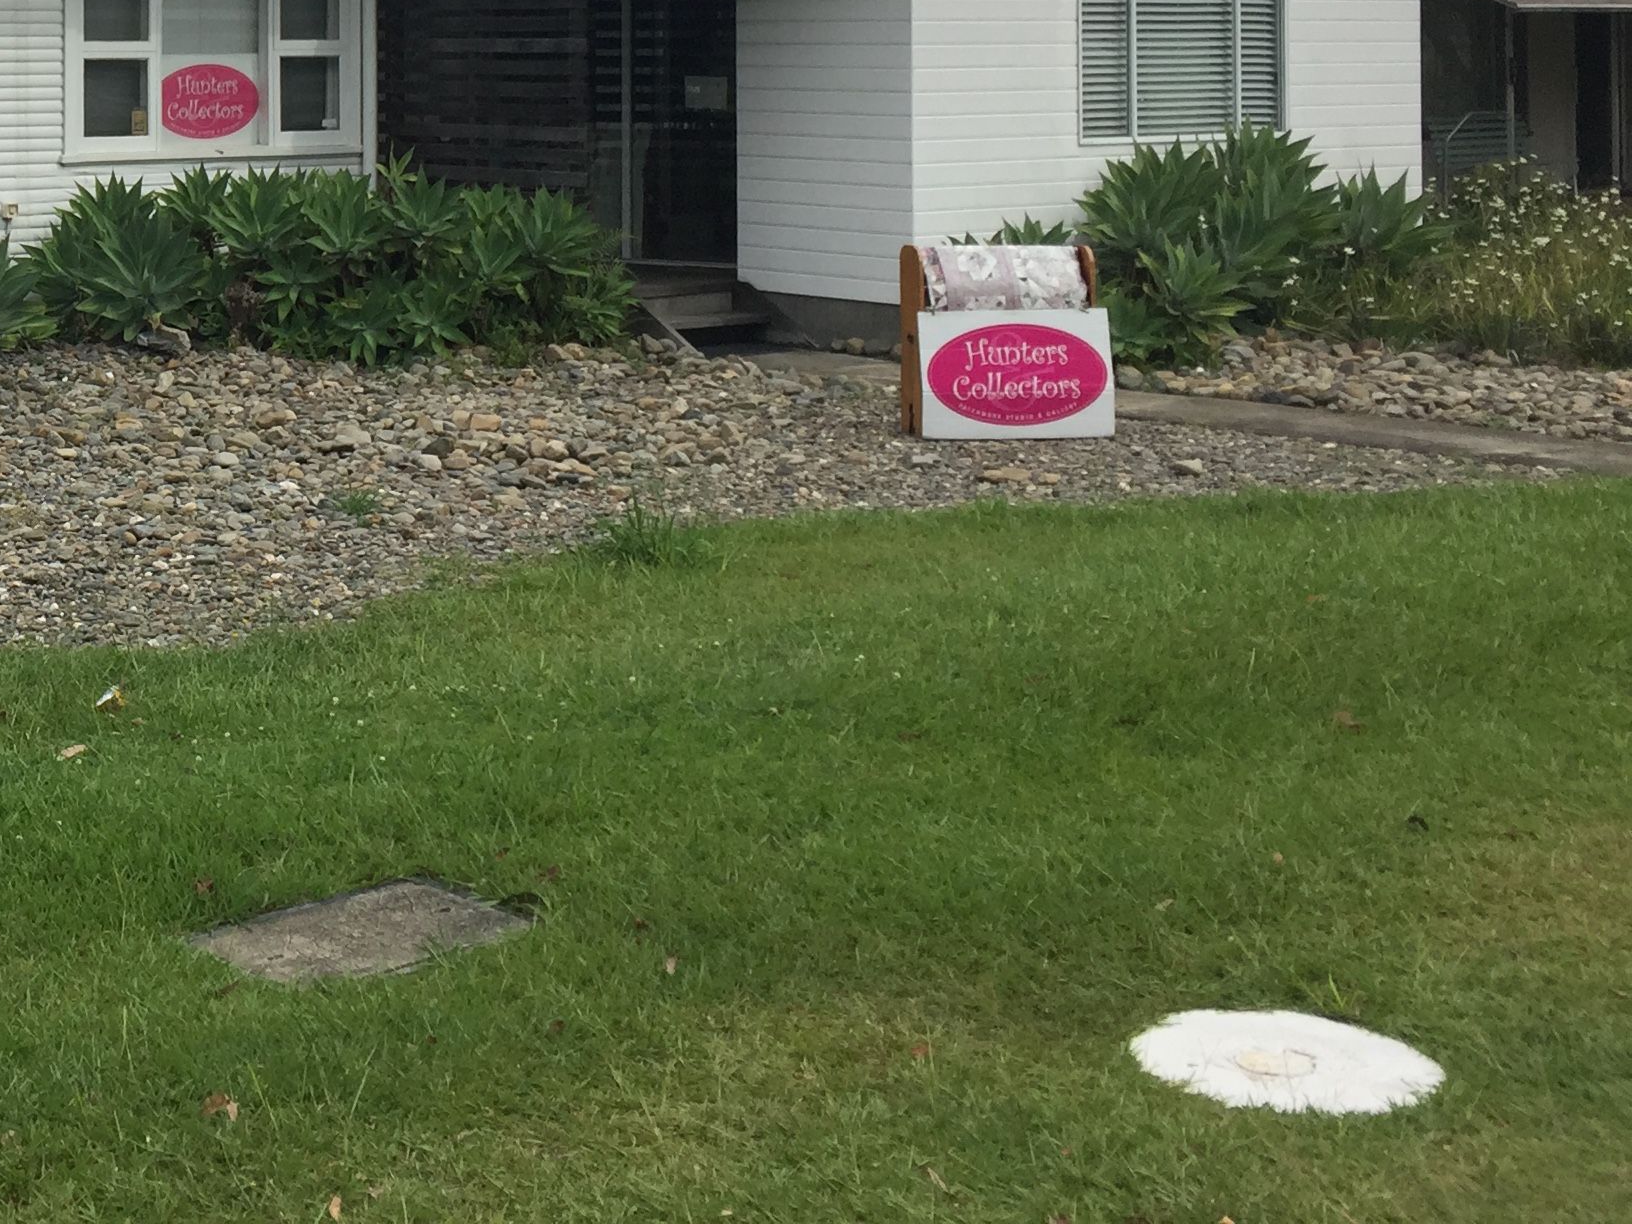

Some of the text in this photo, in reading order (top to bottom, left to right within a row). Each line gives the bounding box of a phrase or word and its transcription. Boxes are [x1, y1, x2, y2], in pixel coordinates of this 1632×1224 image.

[176, 74, 239, 99] Hunters
[167, 99, 245, 121] Collectors
[964, 337, 1068, 371] Hunters
[952, 372, 1081, 401] Collectors
